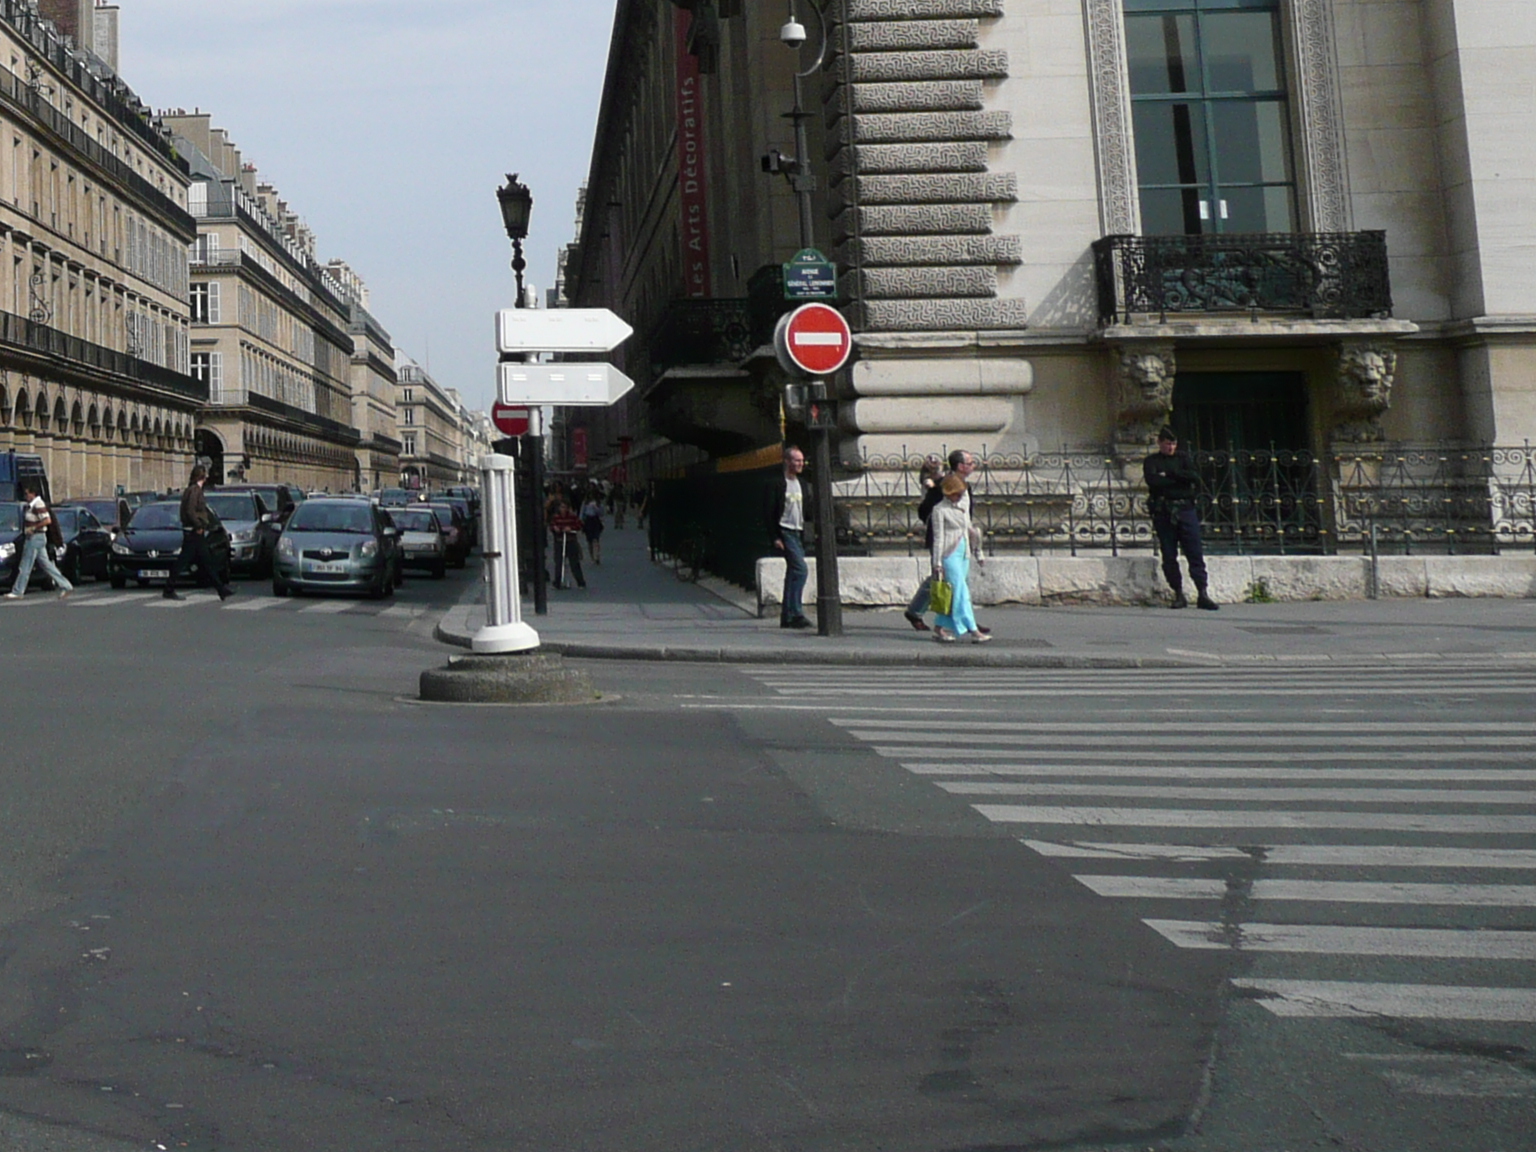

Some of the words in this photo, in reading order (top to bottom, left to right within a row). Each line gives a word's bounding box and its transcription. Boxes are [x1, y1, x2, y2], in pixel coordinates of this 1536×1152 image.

[681, 76, 698, 194] Décoratifs
[689, 204, 701, 251] Arts
[691, 261, 704, 298] Les
